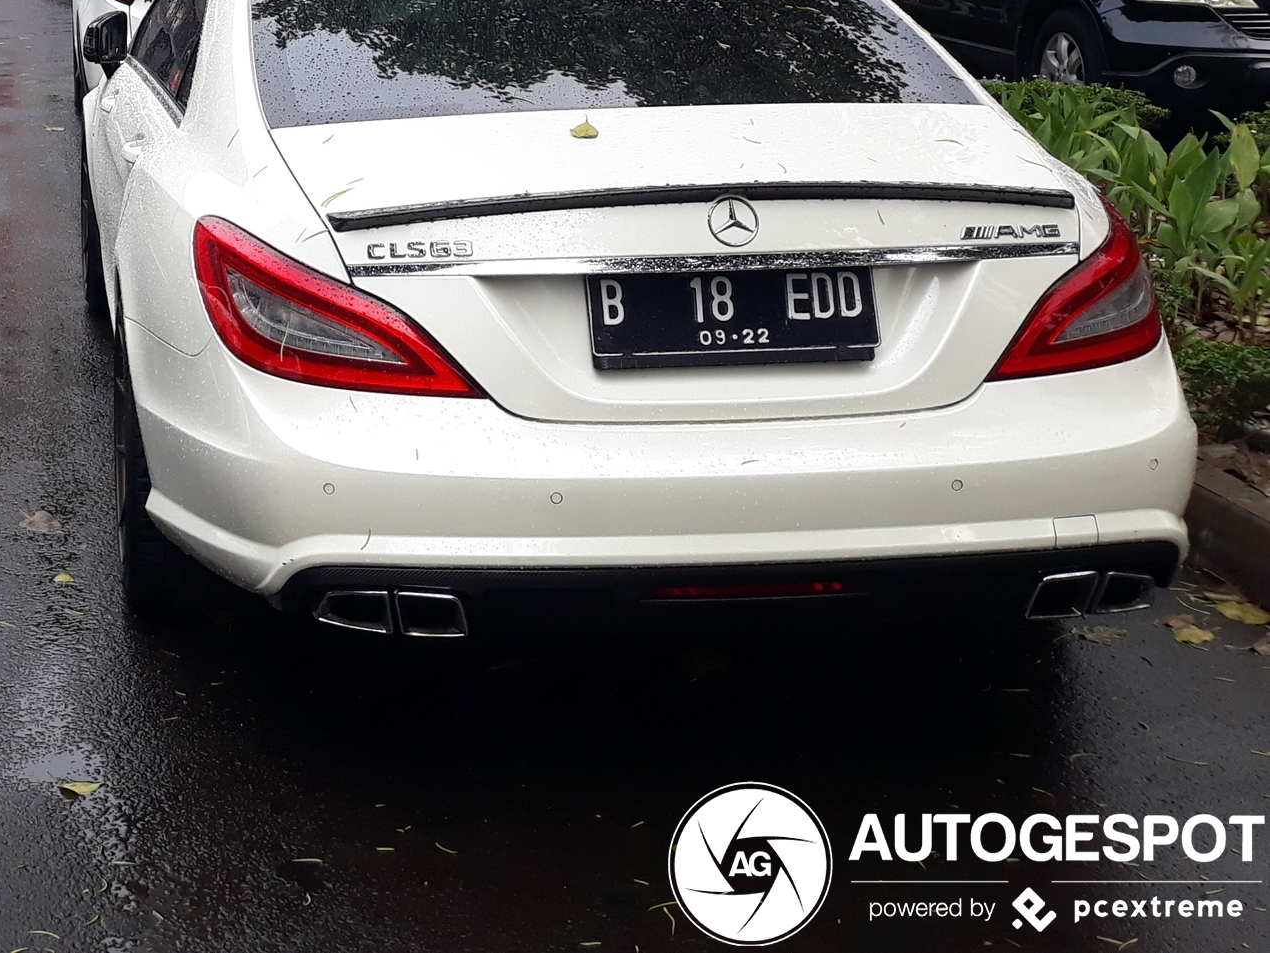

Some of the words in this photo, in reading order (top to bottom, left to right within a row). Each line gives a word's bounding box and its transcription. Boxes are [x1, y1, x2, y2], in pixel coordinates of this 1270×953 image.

[994, 224, 1061, 239] AMG
[599, 278, 625, 326] B
[689, 275, 735, 323] 18
[786, 271, 863, 321] EDD
